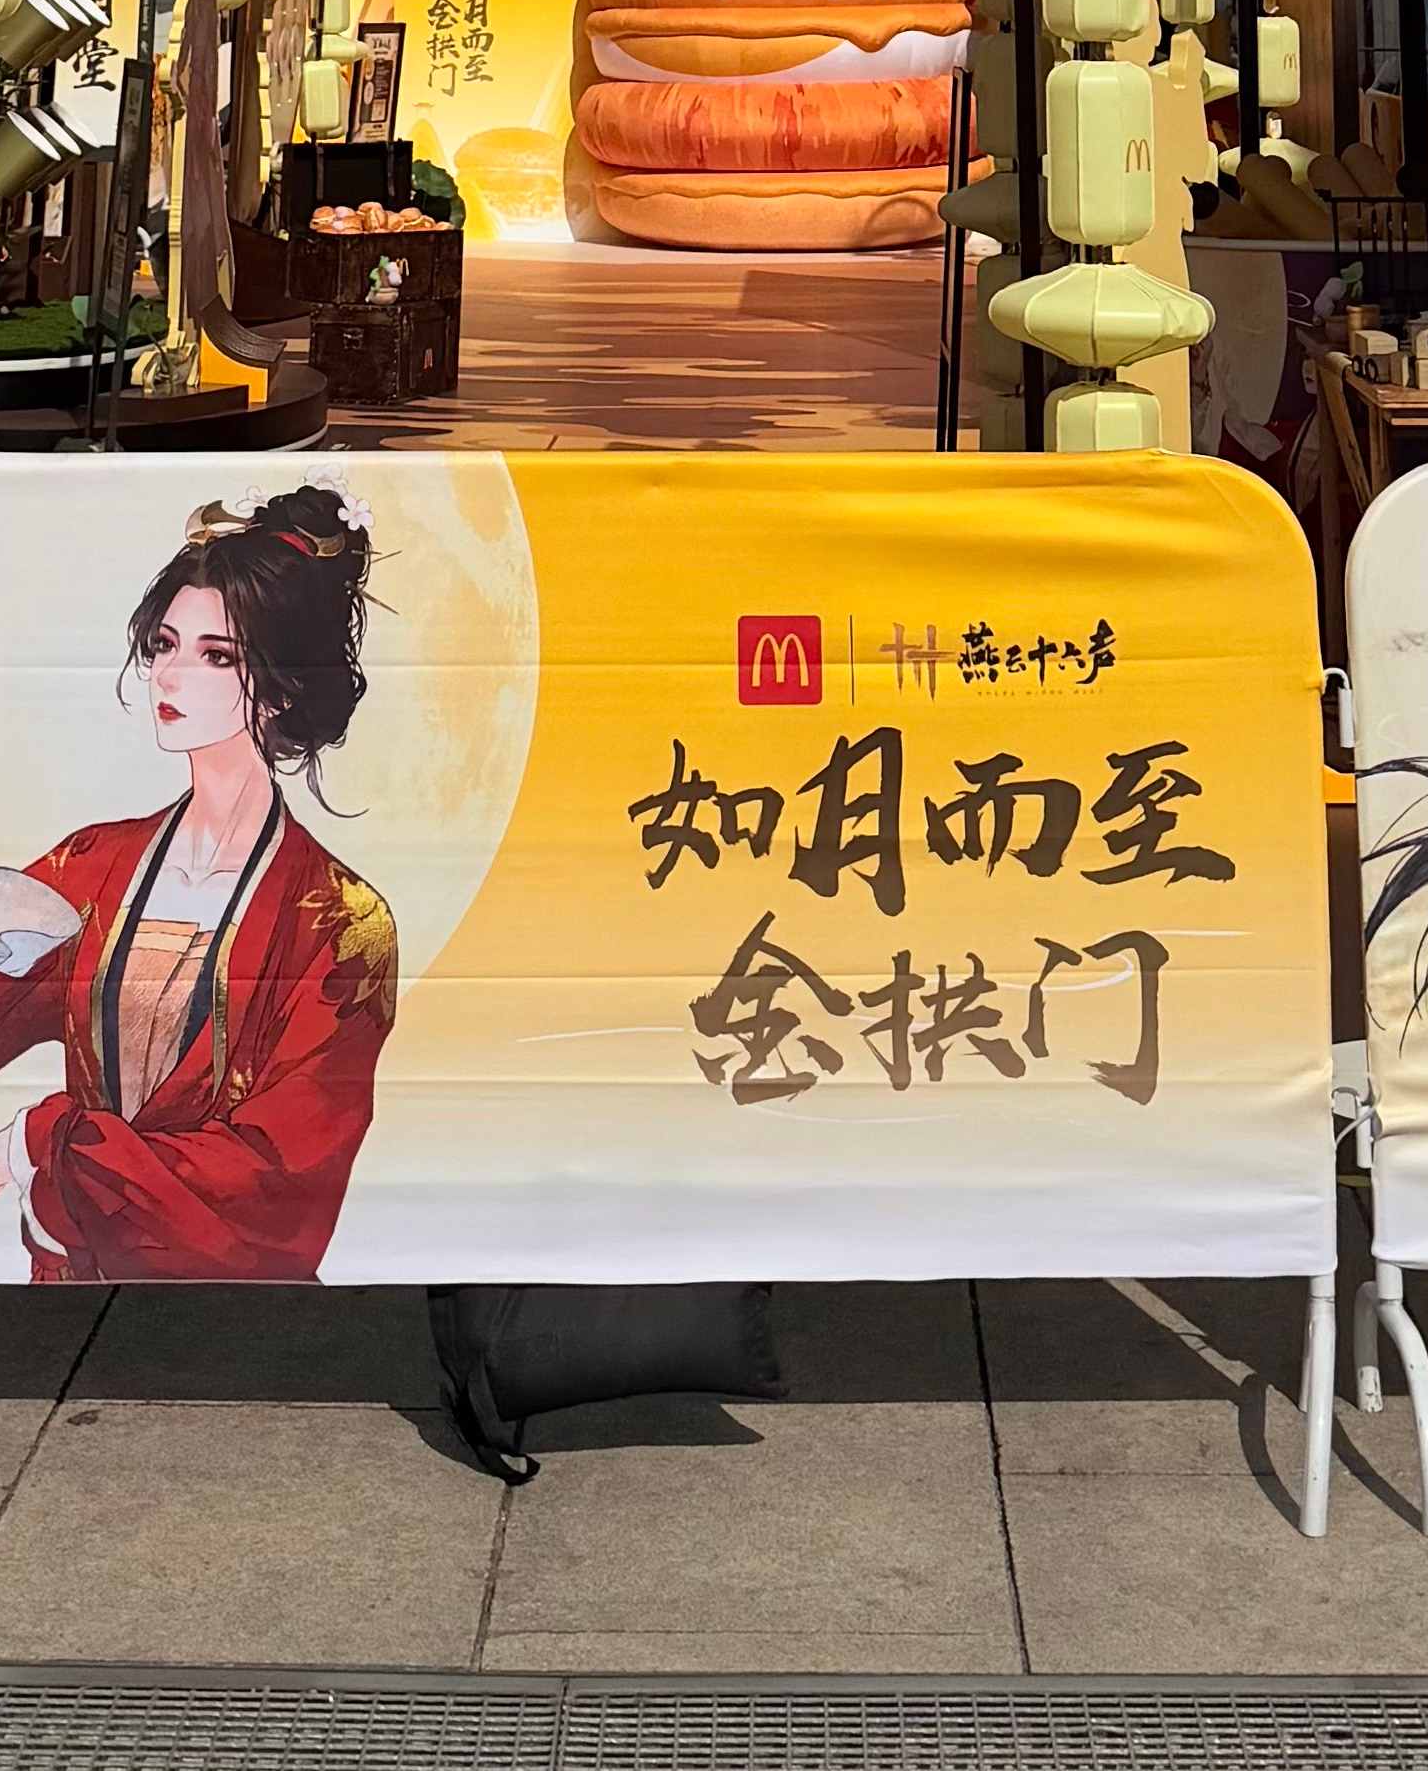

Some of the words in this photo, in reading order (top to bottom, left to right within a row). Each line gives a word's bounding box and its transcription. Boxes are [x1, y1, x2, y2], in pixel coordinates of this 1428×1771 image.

[957, 618, 1117, 687] 燕云十六声
[628, 727, 1236, 916] 如月而至
[689, 910, 1170, 1106] 金拱门
